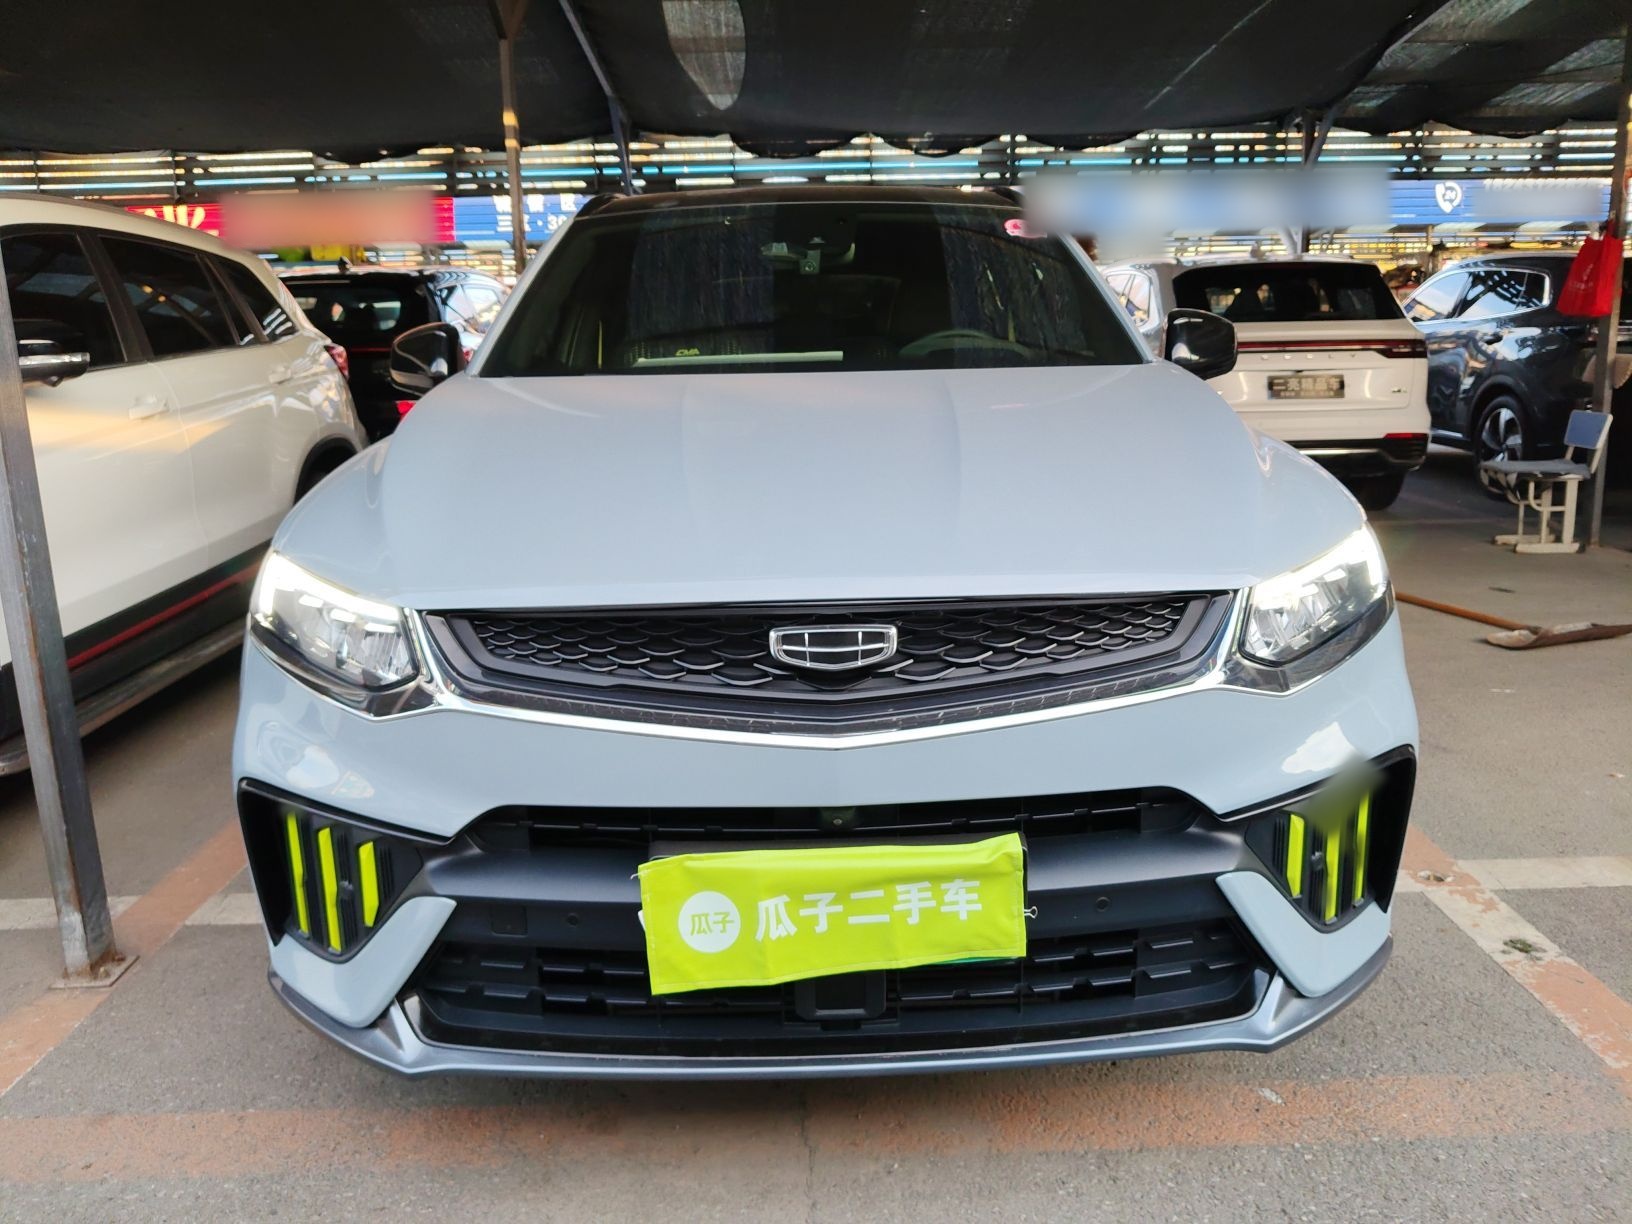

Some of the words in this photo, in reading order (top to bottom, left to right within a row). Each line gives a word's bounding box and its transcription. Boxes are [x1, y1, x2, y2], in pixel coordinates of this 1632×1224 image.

[690, 911, 735, 936] 瓜子
[755, 878, 983, 942] 瓜子二手车
